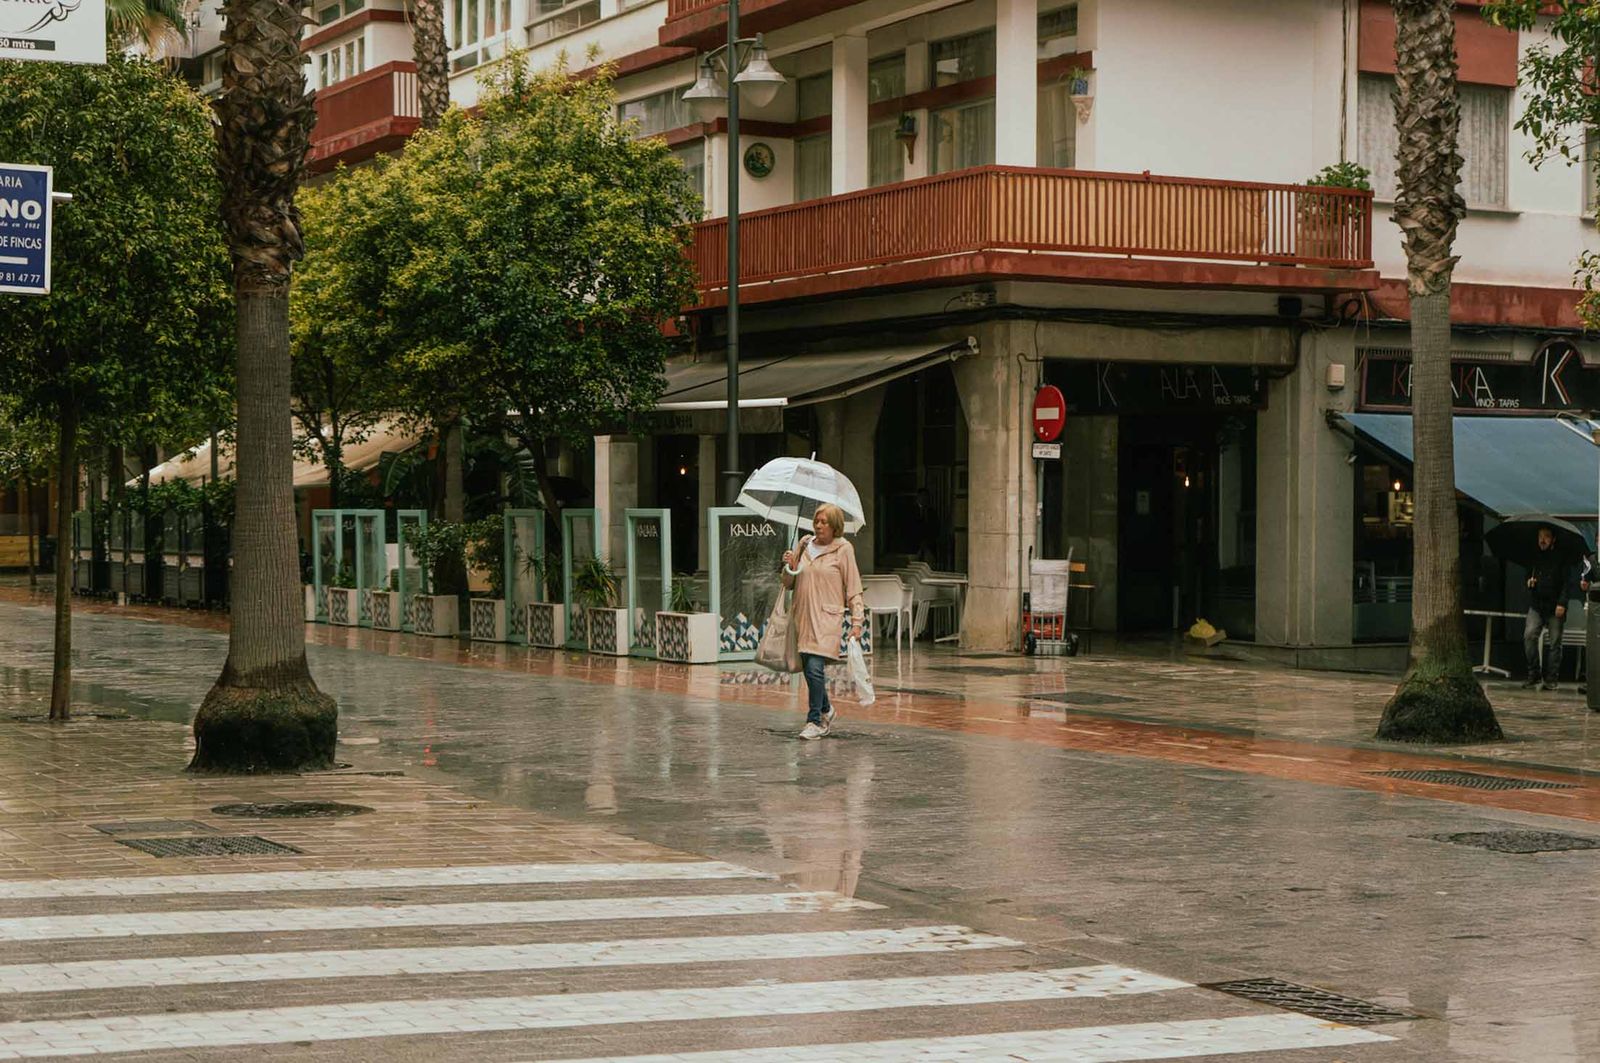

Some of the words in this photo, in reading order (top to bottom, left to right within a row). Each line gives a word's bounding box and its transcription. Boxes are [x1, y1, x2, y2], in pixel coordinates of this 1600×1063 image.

[12, 40, 36, 49] mtrs
[0, 198, 42, 221] NO
[10, 236, 42, 250] FINCAS
[6, 273, 15, 282] 81
[18, 274, 29, 283] 47
[30, 275, 41, 284] 77
[1498, 398, 1520, 408] TAPAS
[730, 523, 777, 537] KALAKA
